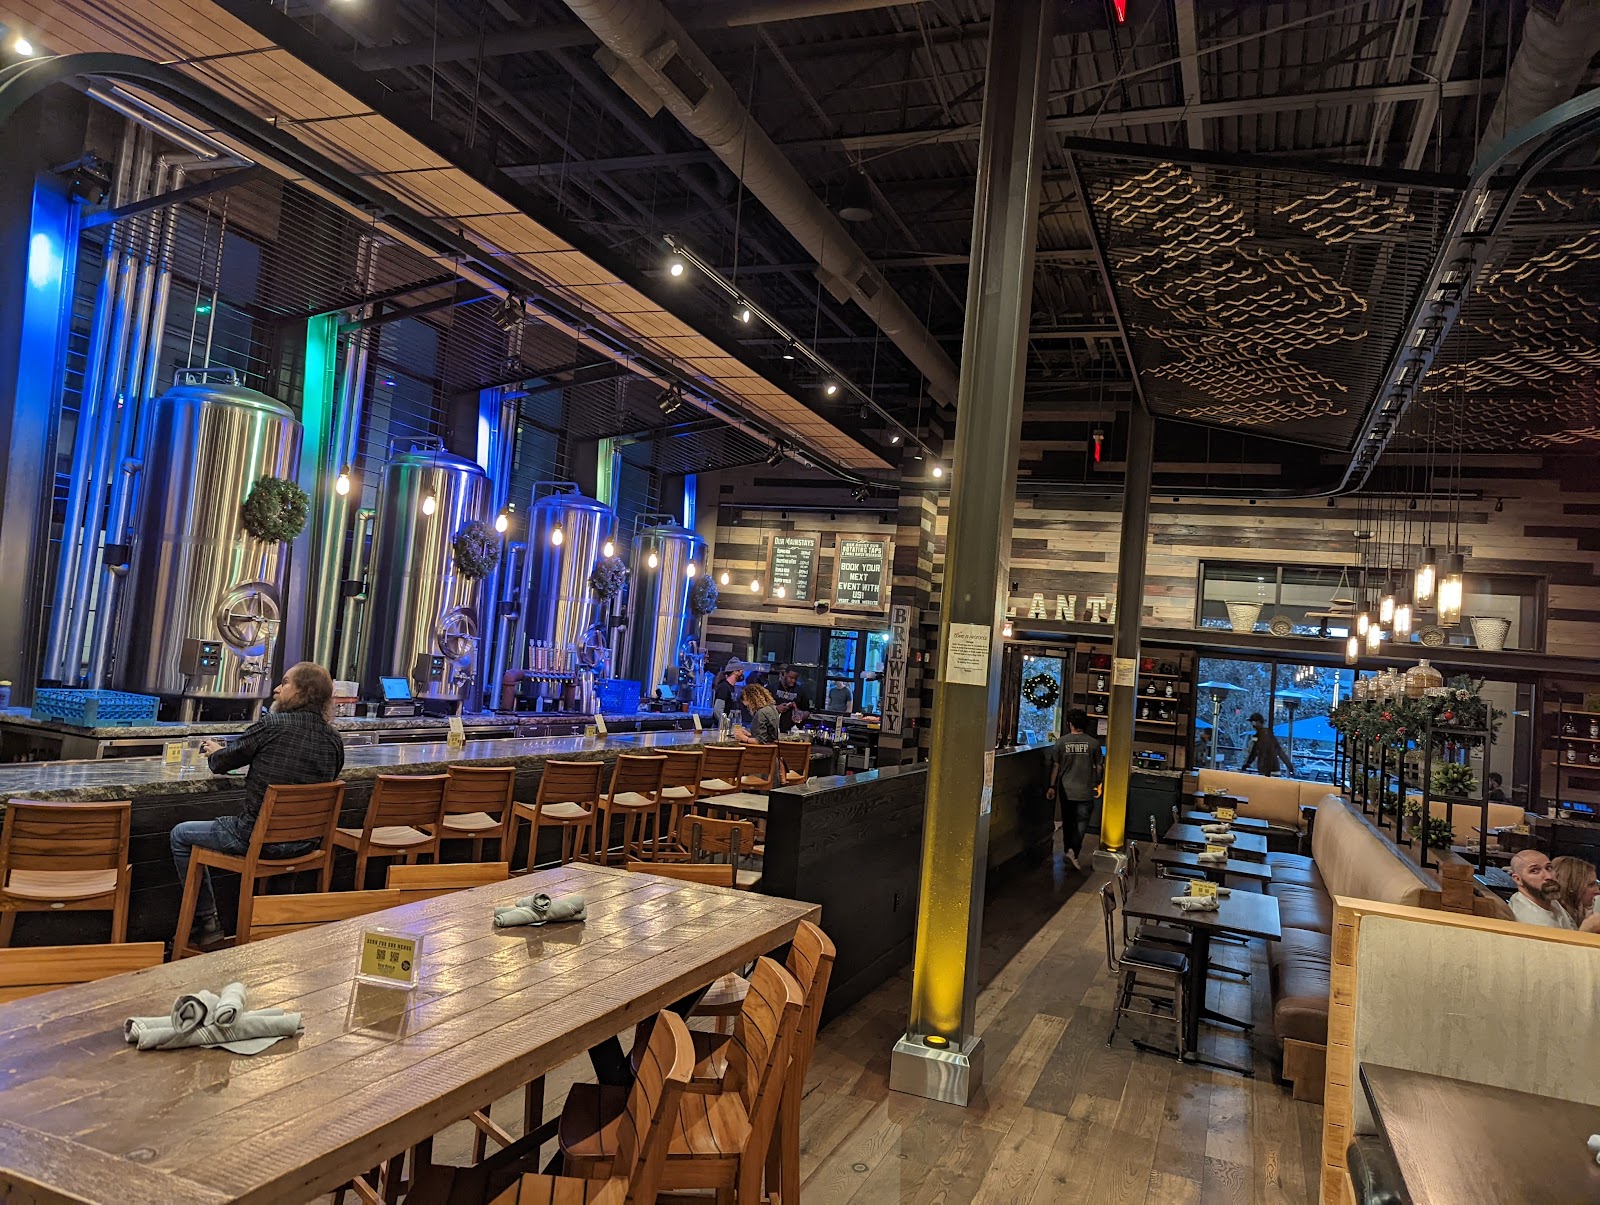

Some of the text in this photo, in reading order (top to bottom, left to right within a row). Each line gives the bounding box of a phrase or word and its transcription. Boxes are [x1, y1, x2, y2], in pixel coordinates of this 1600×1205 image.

[841, 562, 881, 572] BOOK YOUR
[849, 572, 869, 581] NEXT
[838, 581, 880, 592] EVENT WITH
[852, 590, 864, 599] US!
[886, 608, 906, 731] BREWERY
[1065, 743, 1089, 753] STAFF
